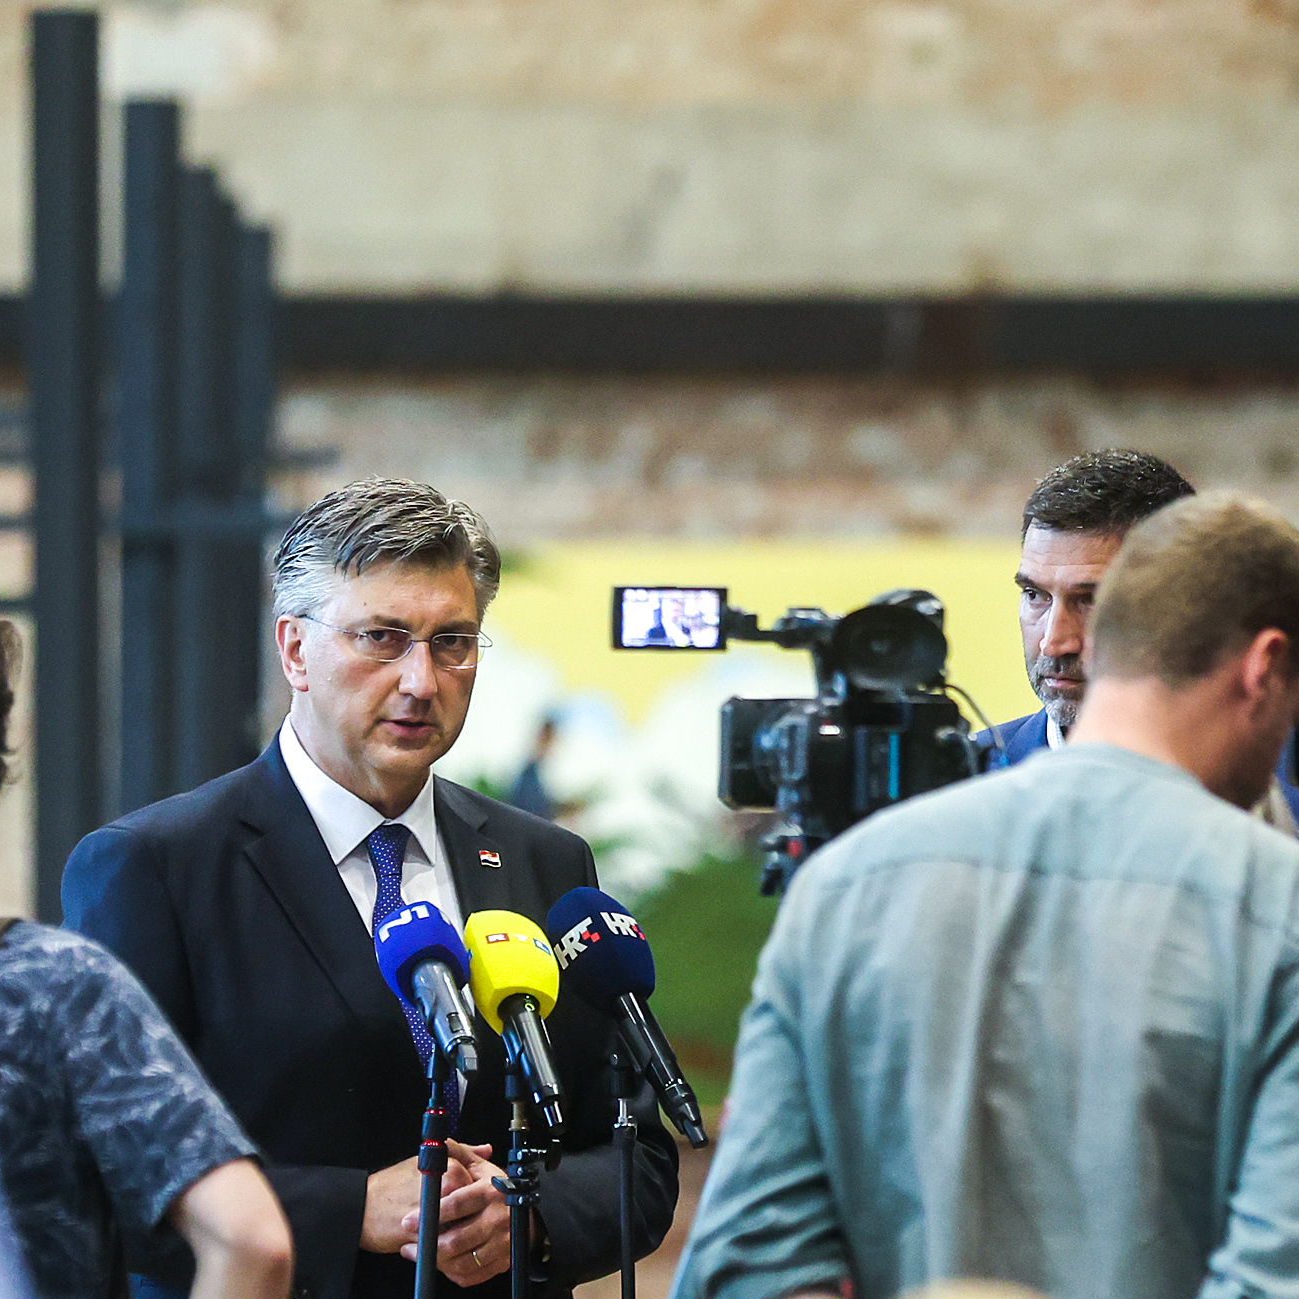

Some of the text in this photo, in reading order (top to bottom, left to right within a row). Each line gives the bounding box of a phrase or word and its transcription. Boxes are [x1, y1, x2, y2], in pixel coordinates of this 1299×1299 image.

[600, 911, 646, 941] HRT
[486, 932, 552, 956] RTL
[554, 916, 601, 970] HRT
